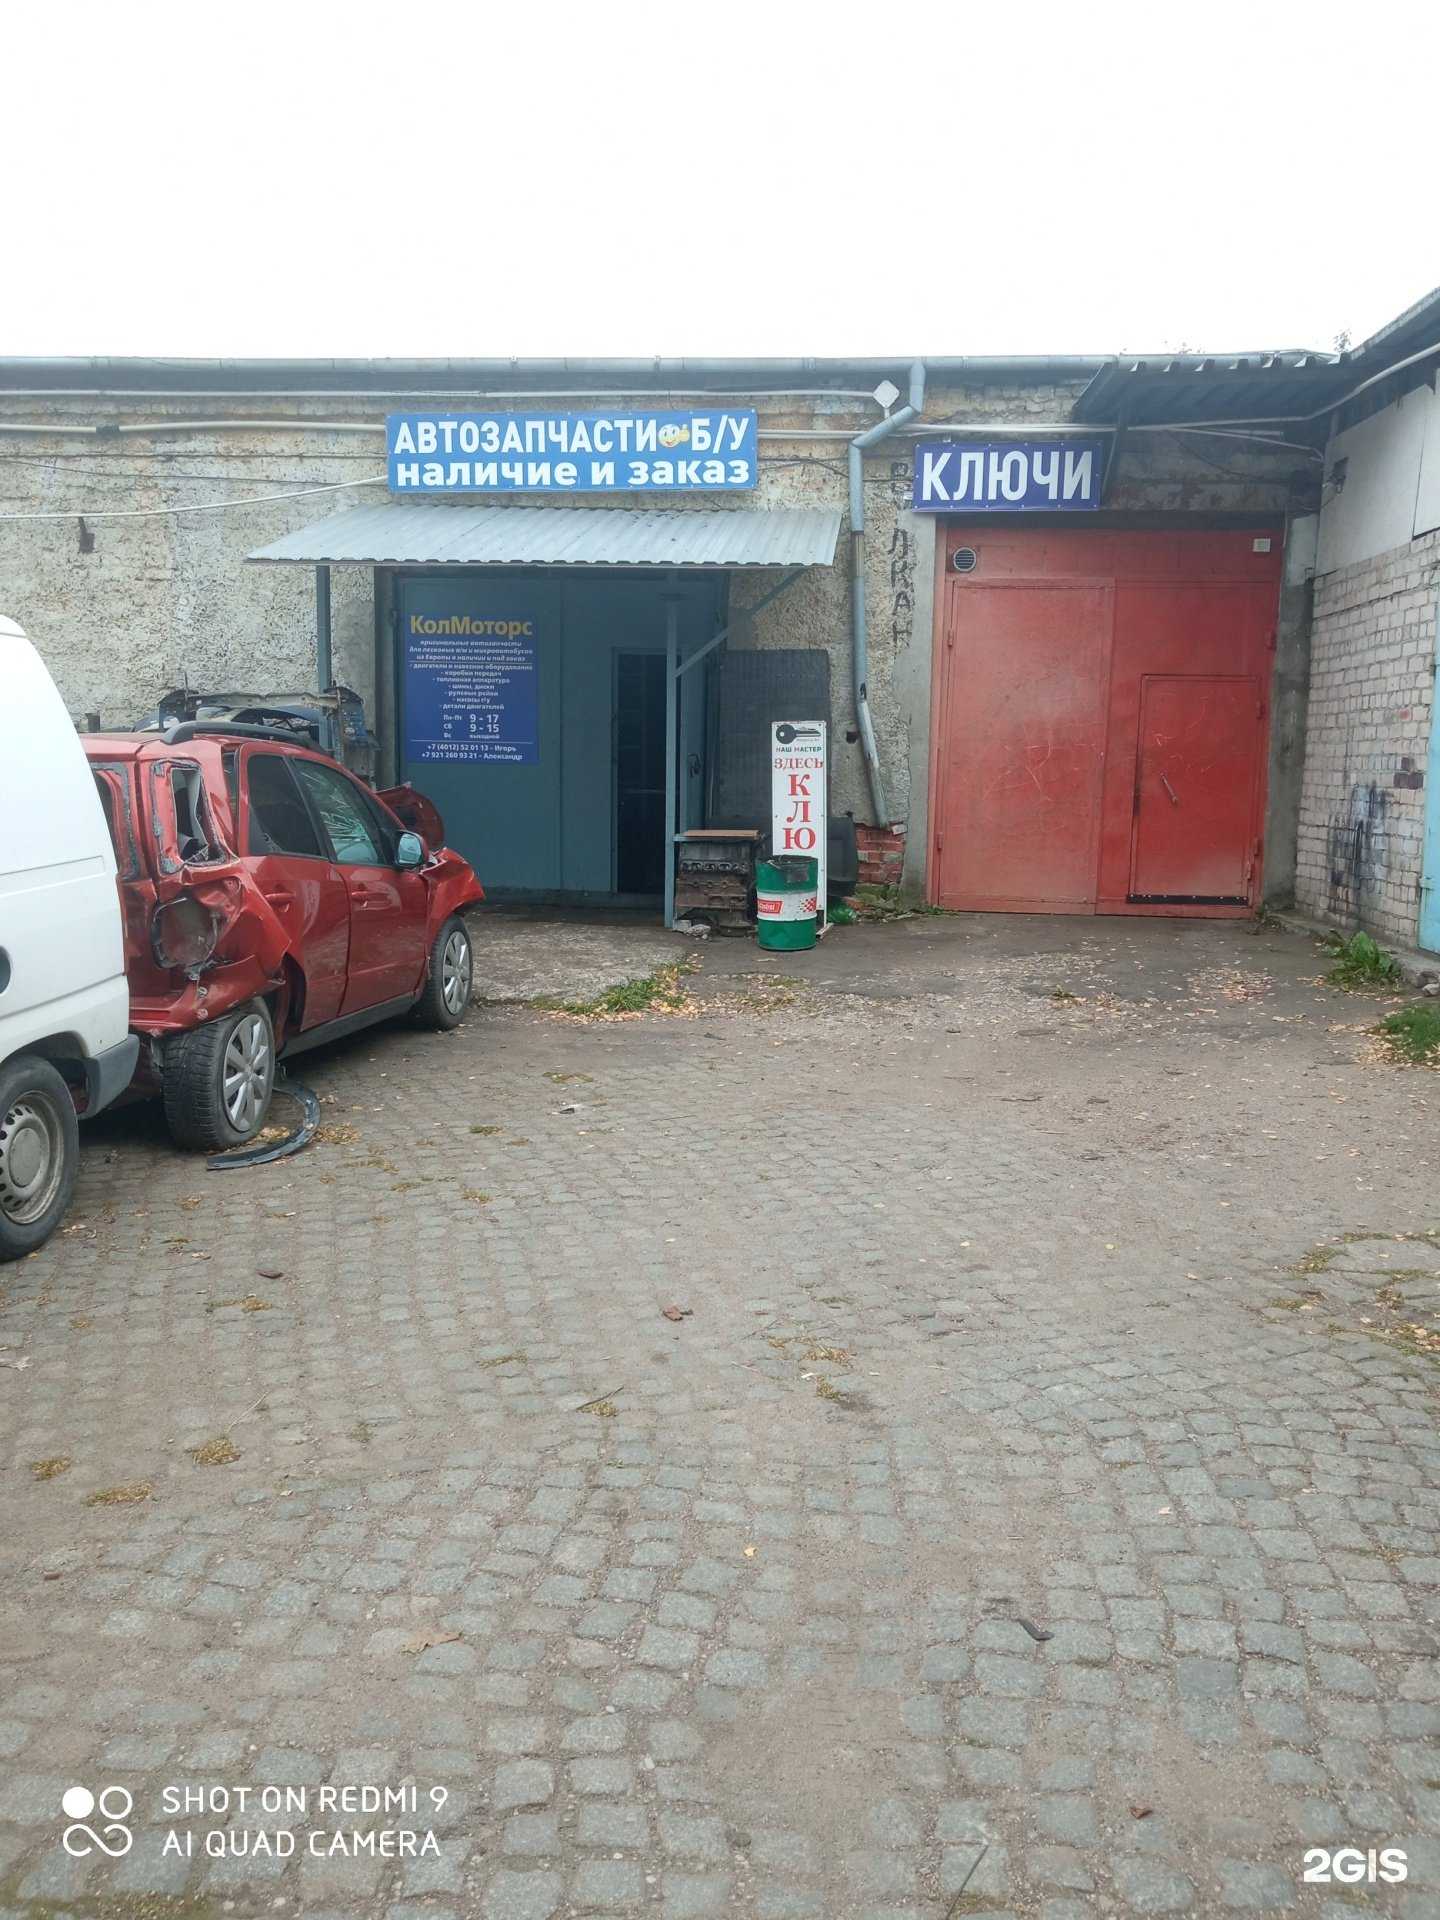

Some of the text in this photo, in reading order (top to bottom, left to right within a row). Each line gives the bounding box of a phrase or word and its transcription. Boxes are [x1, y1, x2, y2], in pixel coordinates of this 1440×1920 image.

[394, 415, 749, 454] АВТОЗАПЧАСТИ Б/У
[397, 459, 749, 486] наличие и заказ
[922, 451, 1092, 500] КЛЮЧИ
[410, 615, 533, 640] КолМоторс
[469, 714, 477, 723] 9
[487, 714, 500, 723] 17
[469, 723, 477, 733] 9
[487, 723, 500, 733] 15
[774, 757, 824, 769] ЗДЕСЬ
